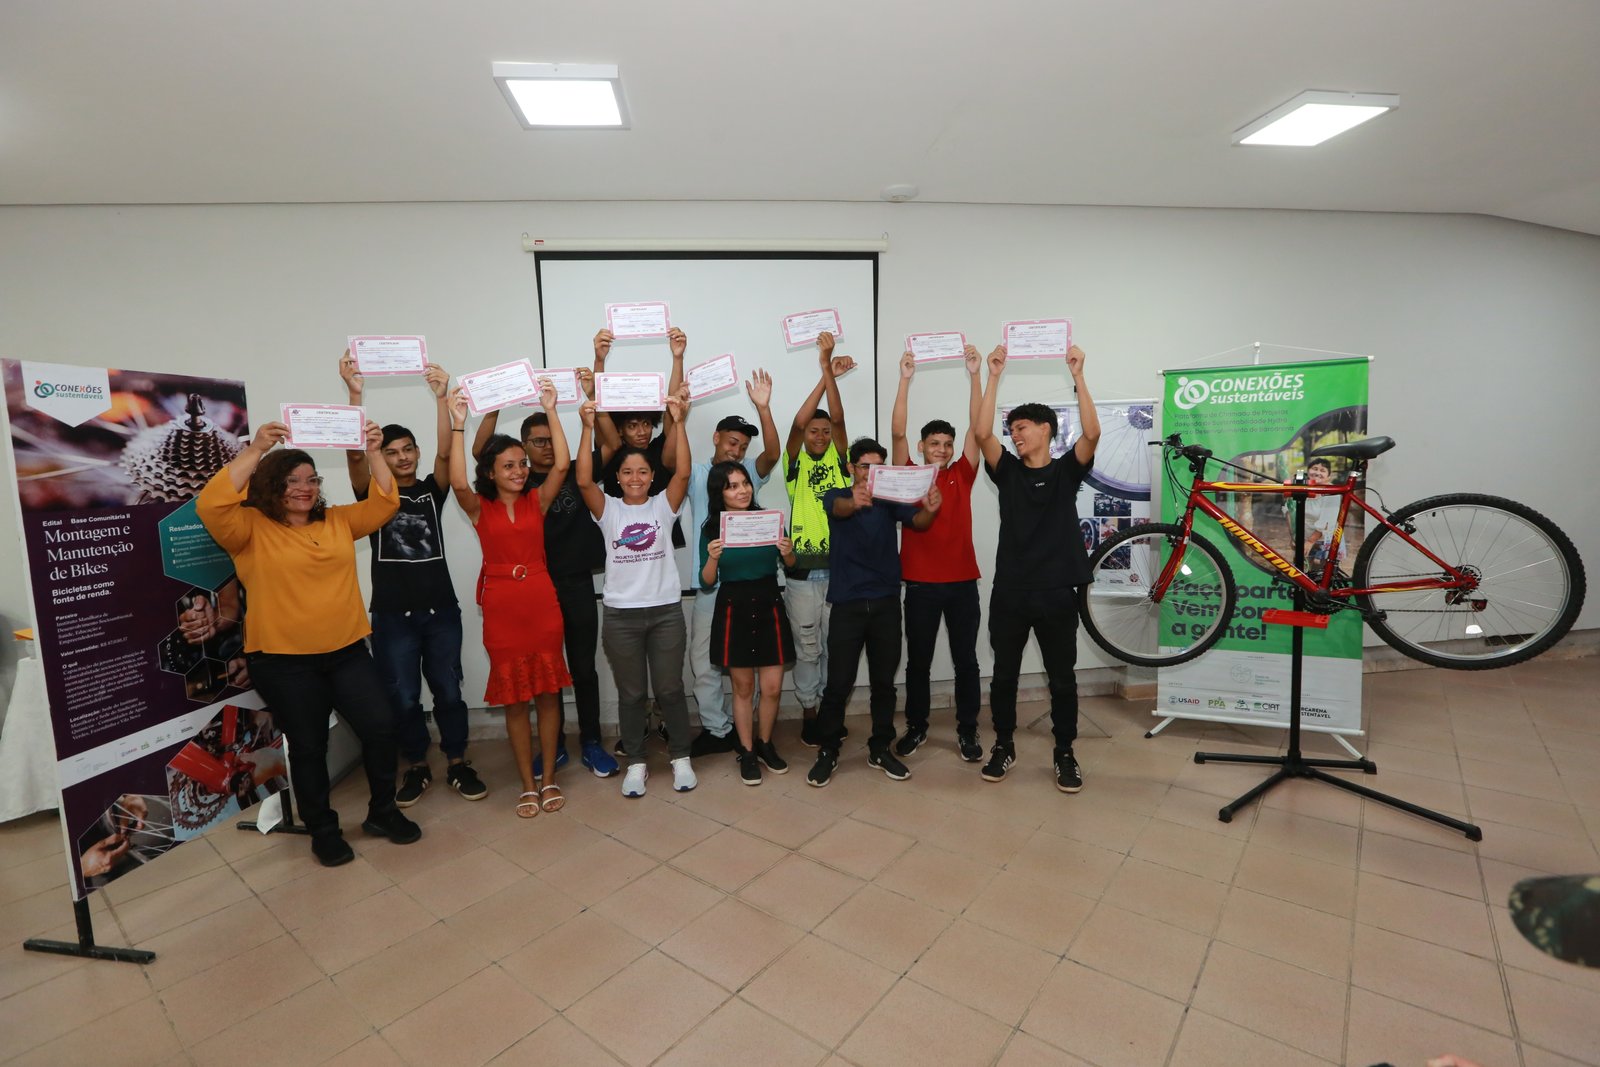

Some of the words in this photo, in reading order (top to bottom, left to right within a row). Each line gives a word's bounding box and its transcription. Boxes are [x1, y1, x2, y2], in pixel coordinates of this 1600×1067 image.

[55, 384, 102, 394] CONEXÕES
[1210, 373, 1304, 392] CONEXÕES
[56, 392, 104, 400] sustentáveis
[1210, 388, 1304, 404] sustentáveis
[88, 514, 126, 522] Comunitária
[44, 526, 120, 544] Montagem
[122, 525, 130, 534] e
[168, 524, 203, 532] Resultados
[47, 541, 134, 562] Manutenção
[1218, 517, 1302, 578] HOUSTON
[50, 567, 68, 580] de
[70, 562, 108, 578] Bikes
[52, 584, 92, 597] Bicicletas
[94, 581, 114, 590] como
[53, 596, 74, 605] fonte
[88, 589, 112, 598] renda.
[1172, 622, 1186, 636] a
[1190, 624, 1266, 640] gnte!
[1208, 699, 1226, 707] PPA
[1262, 702, 1280, 711] CIAT
